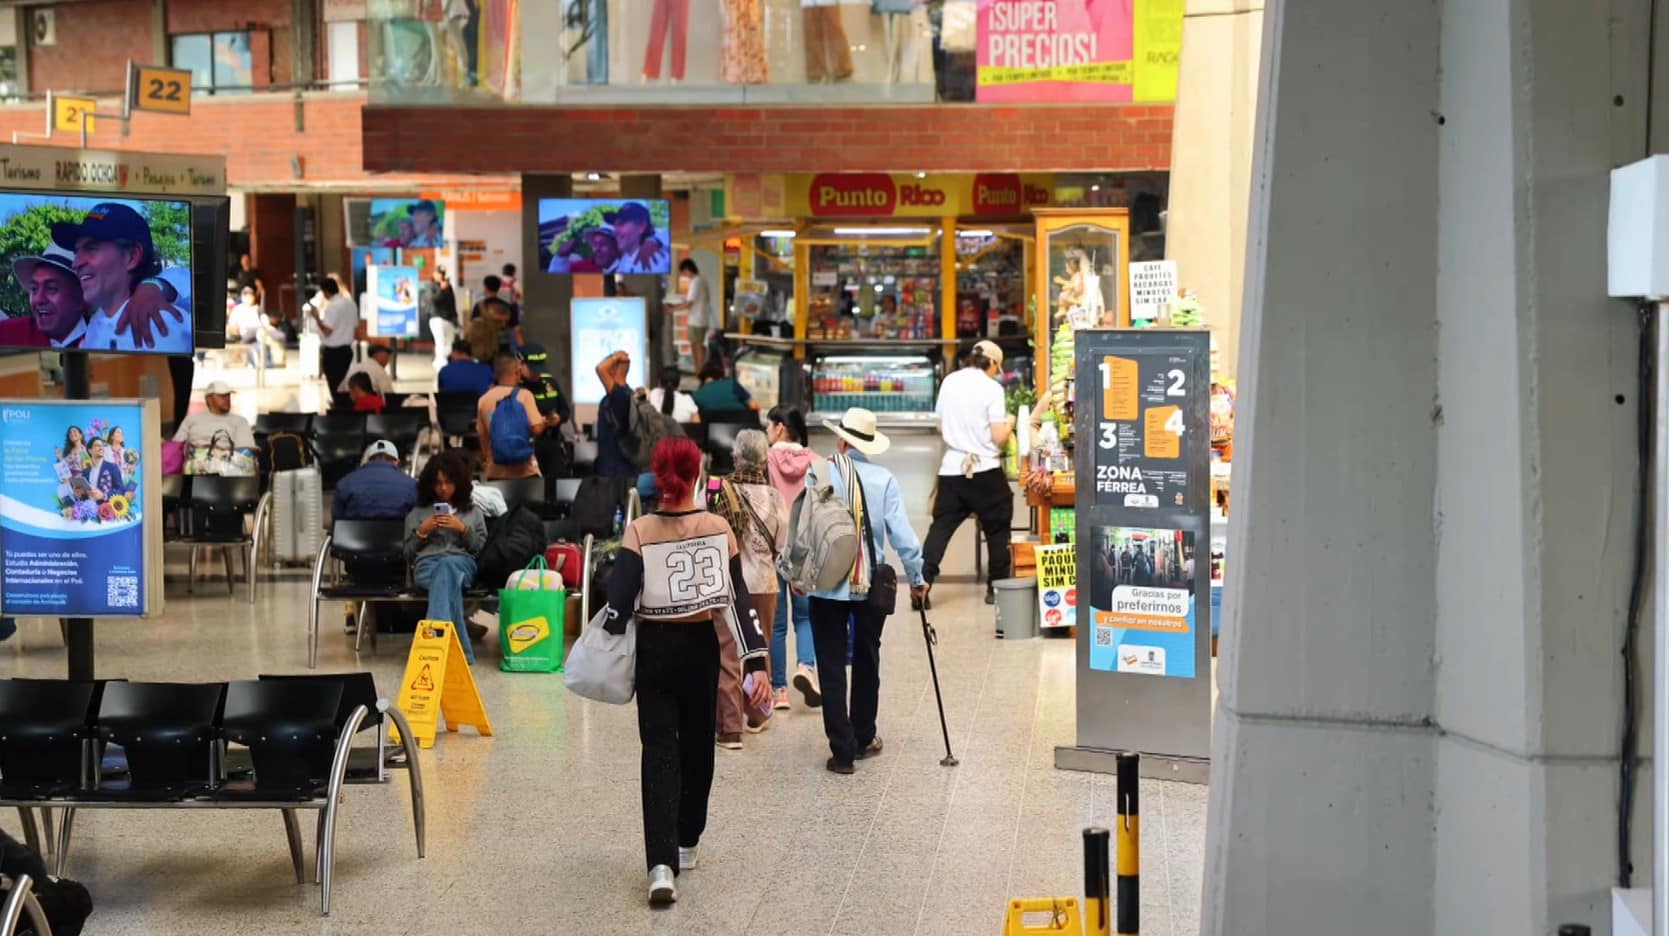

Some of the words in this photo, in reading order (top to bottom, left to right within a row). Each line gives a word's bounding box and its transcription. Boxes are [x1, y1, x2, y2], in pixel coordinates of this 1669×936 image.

[989, 33, 1097, 69] PRECIOS!
[149, 79, 181, 101] 22
[91, 161, 118, 185] OCHOA
[820, 186, 887, 207] Punto
[978, 185, 1016, 205] Punto
[1098, 363, 1111, 390] 1
[1167, 369, 1186, 397] 2
[1164, 410, 1186, 437] 4
[1099, 422, 1117, 450] 3
[1097, 466, 1142, 480] ZONA
[1097, 479, 1146, 494] FÉRREA
[666, 546, 724, 603] 23
[1044, 577, 1065, 588] SIM
[1132, 588, 1165, 599] Gracias
[1168, 592, 1182, 601] por
[1117, 600, 1182, 614] preferirnos
